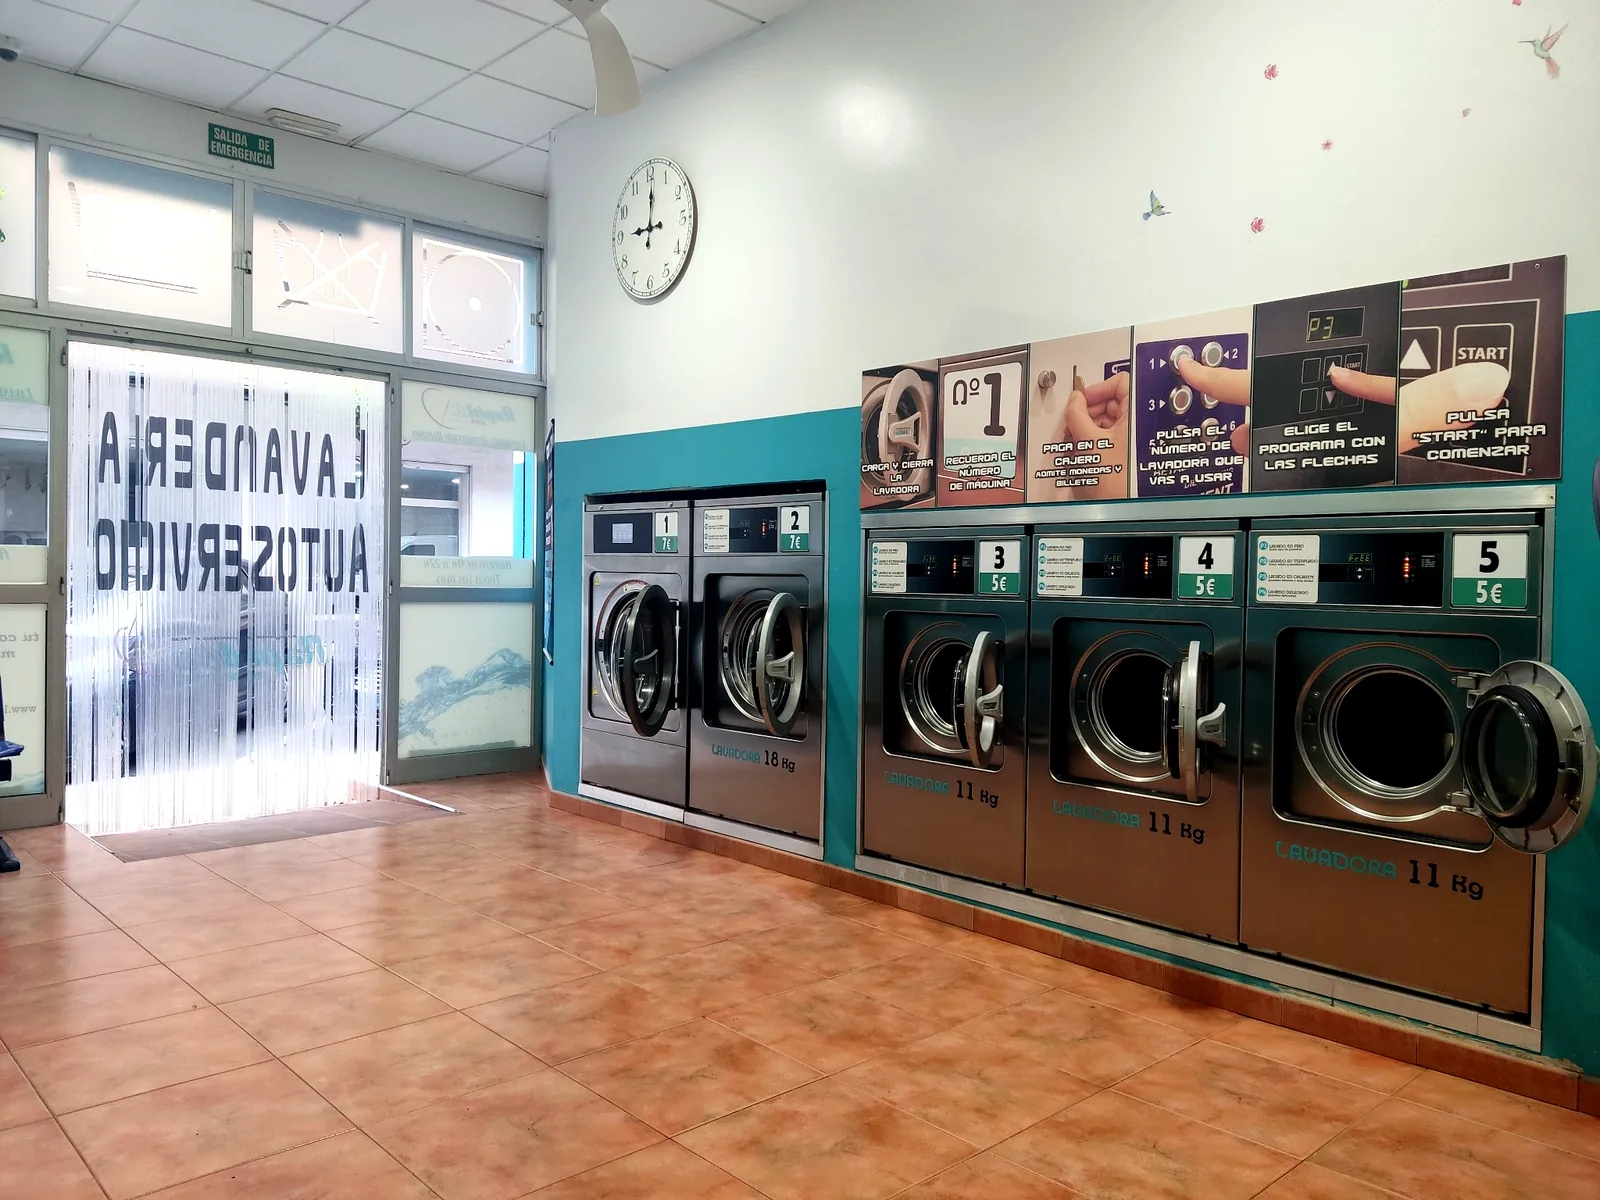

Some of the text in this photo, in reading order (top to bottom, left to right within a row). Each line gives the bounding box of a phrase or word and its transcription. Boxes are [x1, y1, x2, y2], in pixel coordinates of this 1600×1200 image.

[213, 127, 270, 152] SALIDA DE
[211, 140, 273, 167] EMERGENCIA
[646, 166, 654, 183] 12
[664, 170, 668, 184] 1
[632, 180, 639, 196] 11
[675, 185, 681, 201] 2
[620, 205, 628, 220] 10
[617, 231, 624, 245] 9
[674, 238, 681, 254] 4
[621, 254, 628, 269] 8
[632, 271, 638, 285] 7
[662, 263, 670, 278] 5
[647, 275, 654, 289] 6
[1307, 316, 1335, 341] P3
[1232, 348, 1238, 360] 2
[1457, 346, 1508, 361] START
[1149, 358, 1155, 370] 1
[1346, 361, 1362, 370] START
[983, 372, 1006, 437] 1
[1148, 399, 1156, 411] 3
[1446, 408, 1511, 424] PULSA
[1156, 425, 1226, 440] PULSA EL
[1229, 420, 1236, 431] 6
[1284, 421, 1359, 437] ELIGE EL
[1494, 423, 1547, 439] PARA
[1043, 439, 1114, 454] PAGA EN EL
[1151, 440, 1231, 456] NÚMERO DE
[1258, 435, 1386, 455] PROGRAMA CON
[1427, 443, 1531, 461] COMENZAR
[861, 459, 934, 472] CARGA Y CIERRA
[945, 451, 1016, 466] RECUERDA EL
[1054, 454, 1101, 467] CAJERO
[1139, 458, 1210, 471] LAVADORA
[1215, 455, 1244, 466] QUE
[1264, 453, 1380, 472] LAS FLECHAS
[890, 474, 903, 482] LA
[958, 465, 1002, 478] NÚMERO
[1035, 465, 1122, 478] ADMITE MONEDAS Y
[1149, 475, 1175, 486] VAS
[1180, 474, 1191, 484] A
[1194, 472, 1232, 483] USAR
[873, 485, 920, 496] LAVADORA
[949, 478, 1011, 491] DE MÁQUINA
[1056, 478, 1099, 487] BILLETES
[664, 515, 669, 533] 1
[790, 510, 799, 531] 2
[662, 538, 671, 550] 7€
[790, 535, 801, 549] 7€
[994, 546, 1005, 569] 3
[1198, 542, 1214, 570] 4
[1479, 540, 1500, 573] 5
[992, 574, 1007, 592] 5€
[1196, 576, 1216, 596] 5€
[1476, 580, 1503, 604] 5€
[711, 744, 796, 773] LAVADORA 18 Kg
[884, 770, 999, 808] LAVADORA 11 Kg
[1053, 800, 1206, 845] LAVADORA 11 Kg
[1275, 840, 1484, 900] LAVADORA 11 Kg
